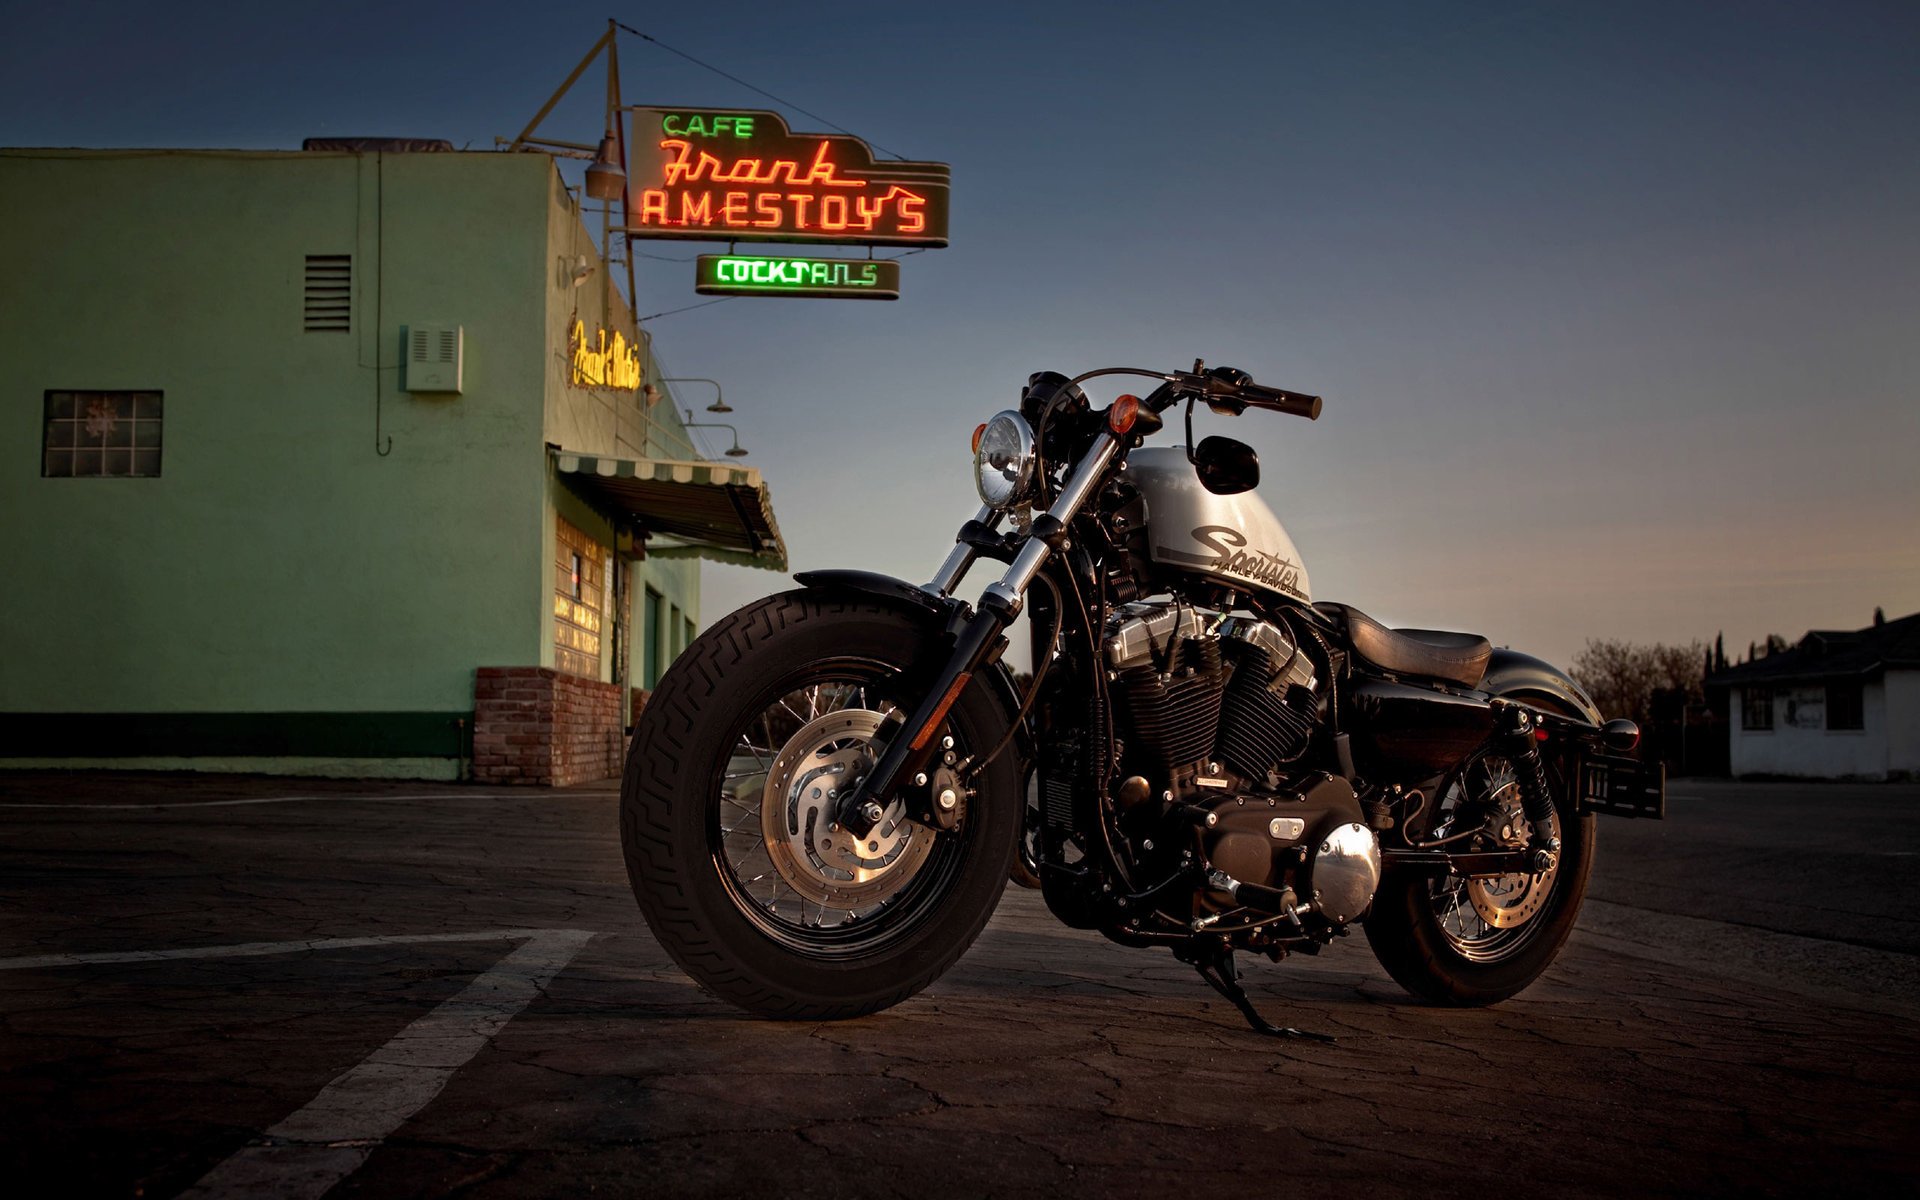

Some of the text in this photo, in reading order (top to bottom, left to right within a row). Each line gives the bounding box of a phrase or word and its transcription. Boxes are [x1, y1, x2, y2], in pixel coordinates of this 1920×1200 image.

[662, 115, 754, 138] CAFE
[659, 139, 867, 186] Frank
[641, 186, 925, 232] AMESTOY'S
[717, 258, 877, 286] COCKTAILS
[1210, 559, 1303, 599] HARLEY-DAVIDSON
